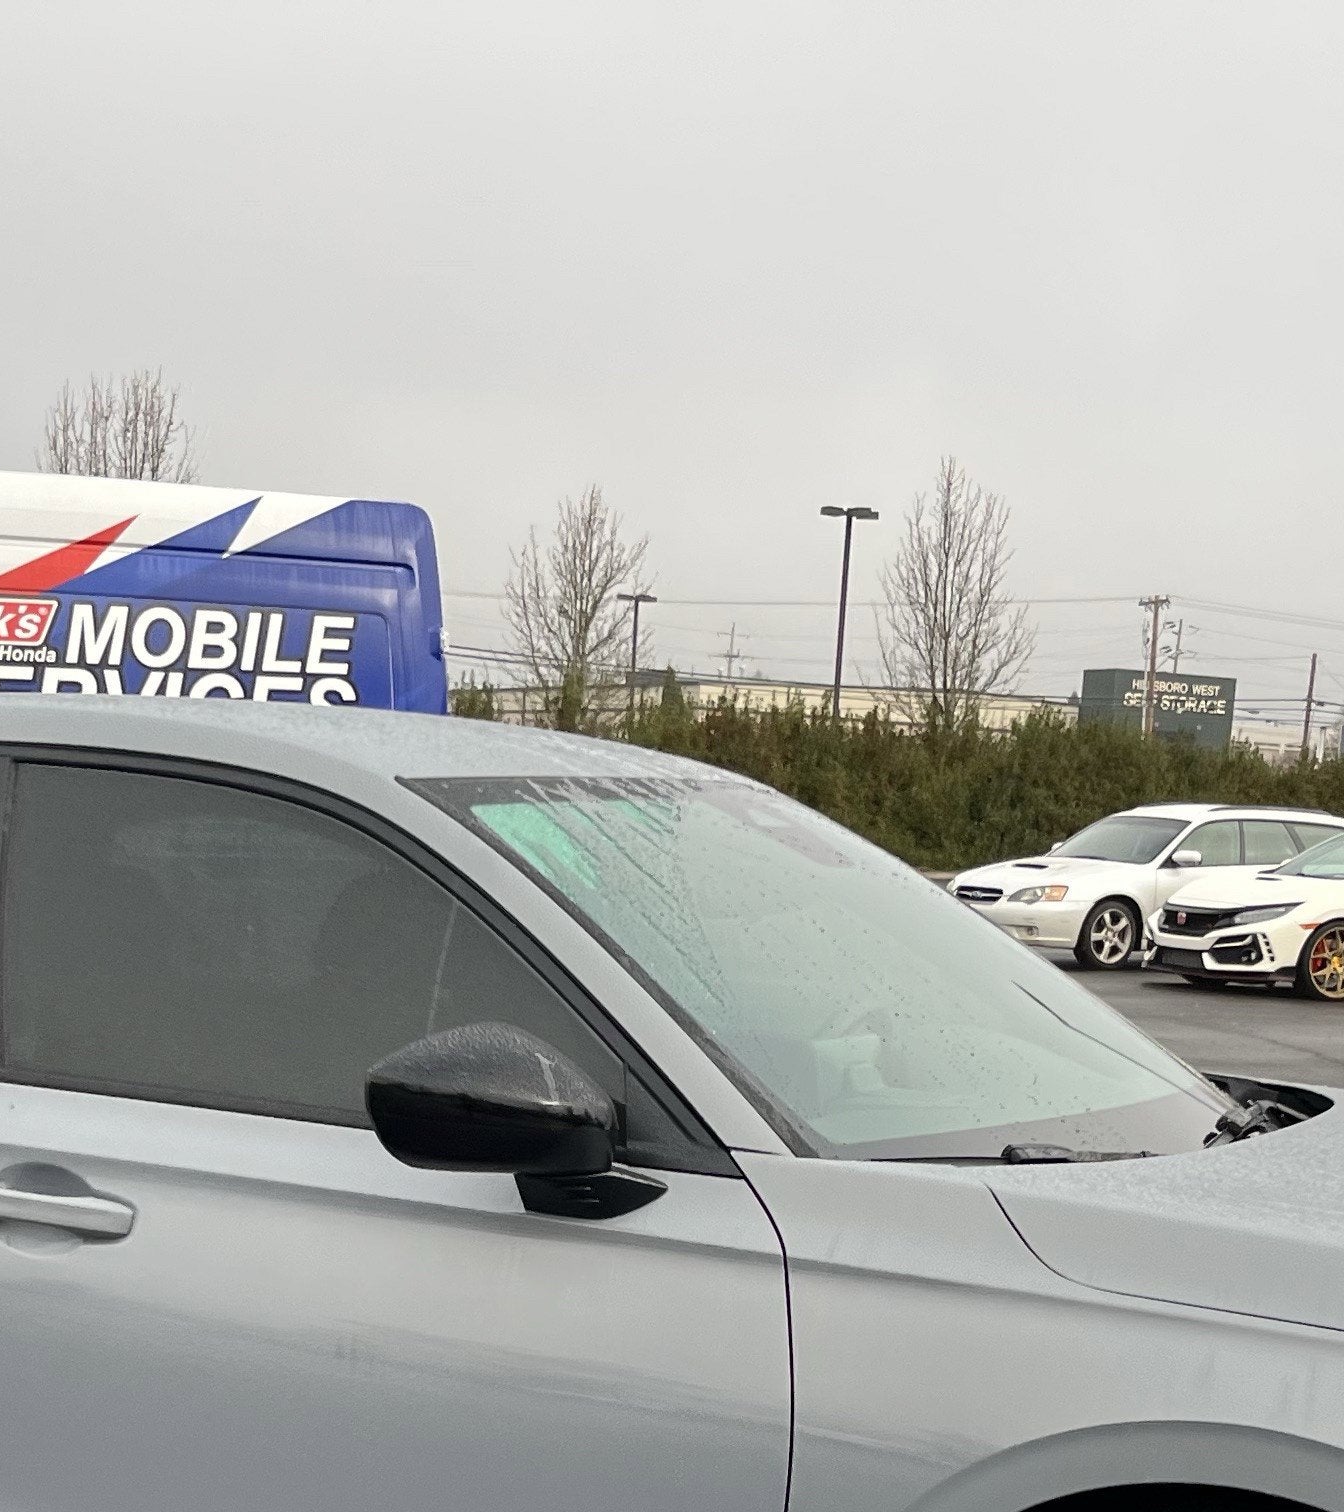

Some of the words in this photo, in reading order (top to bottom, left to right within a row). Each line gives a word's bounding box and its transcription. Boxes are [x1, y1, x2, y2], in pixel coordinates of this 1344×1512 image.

[65, 603, 355, 675] MOBILE
[1132, 678, 1189, 695] HISBORO
[1192, 683, 1221, 697] WEST
[1123, 692, 1158, 707] SE
[1160, 695, 1227, 715] STORAGE
